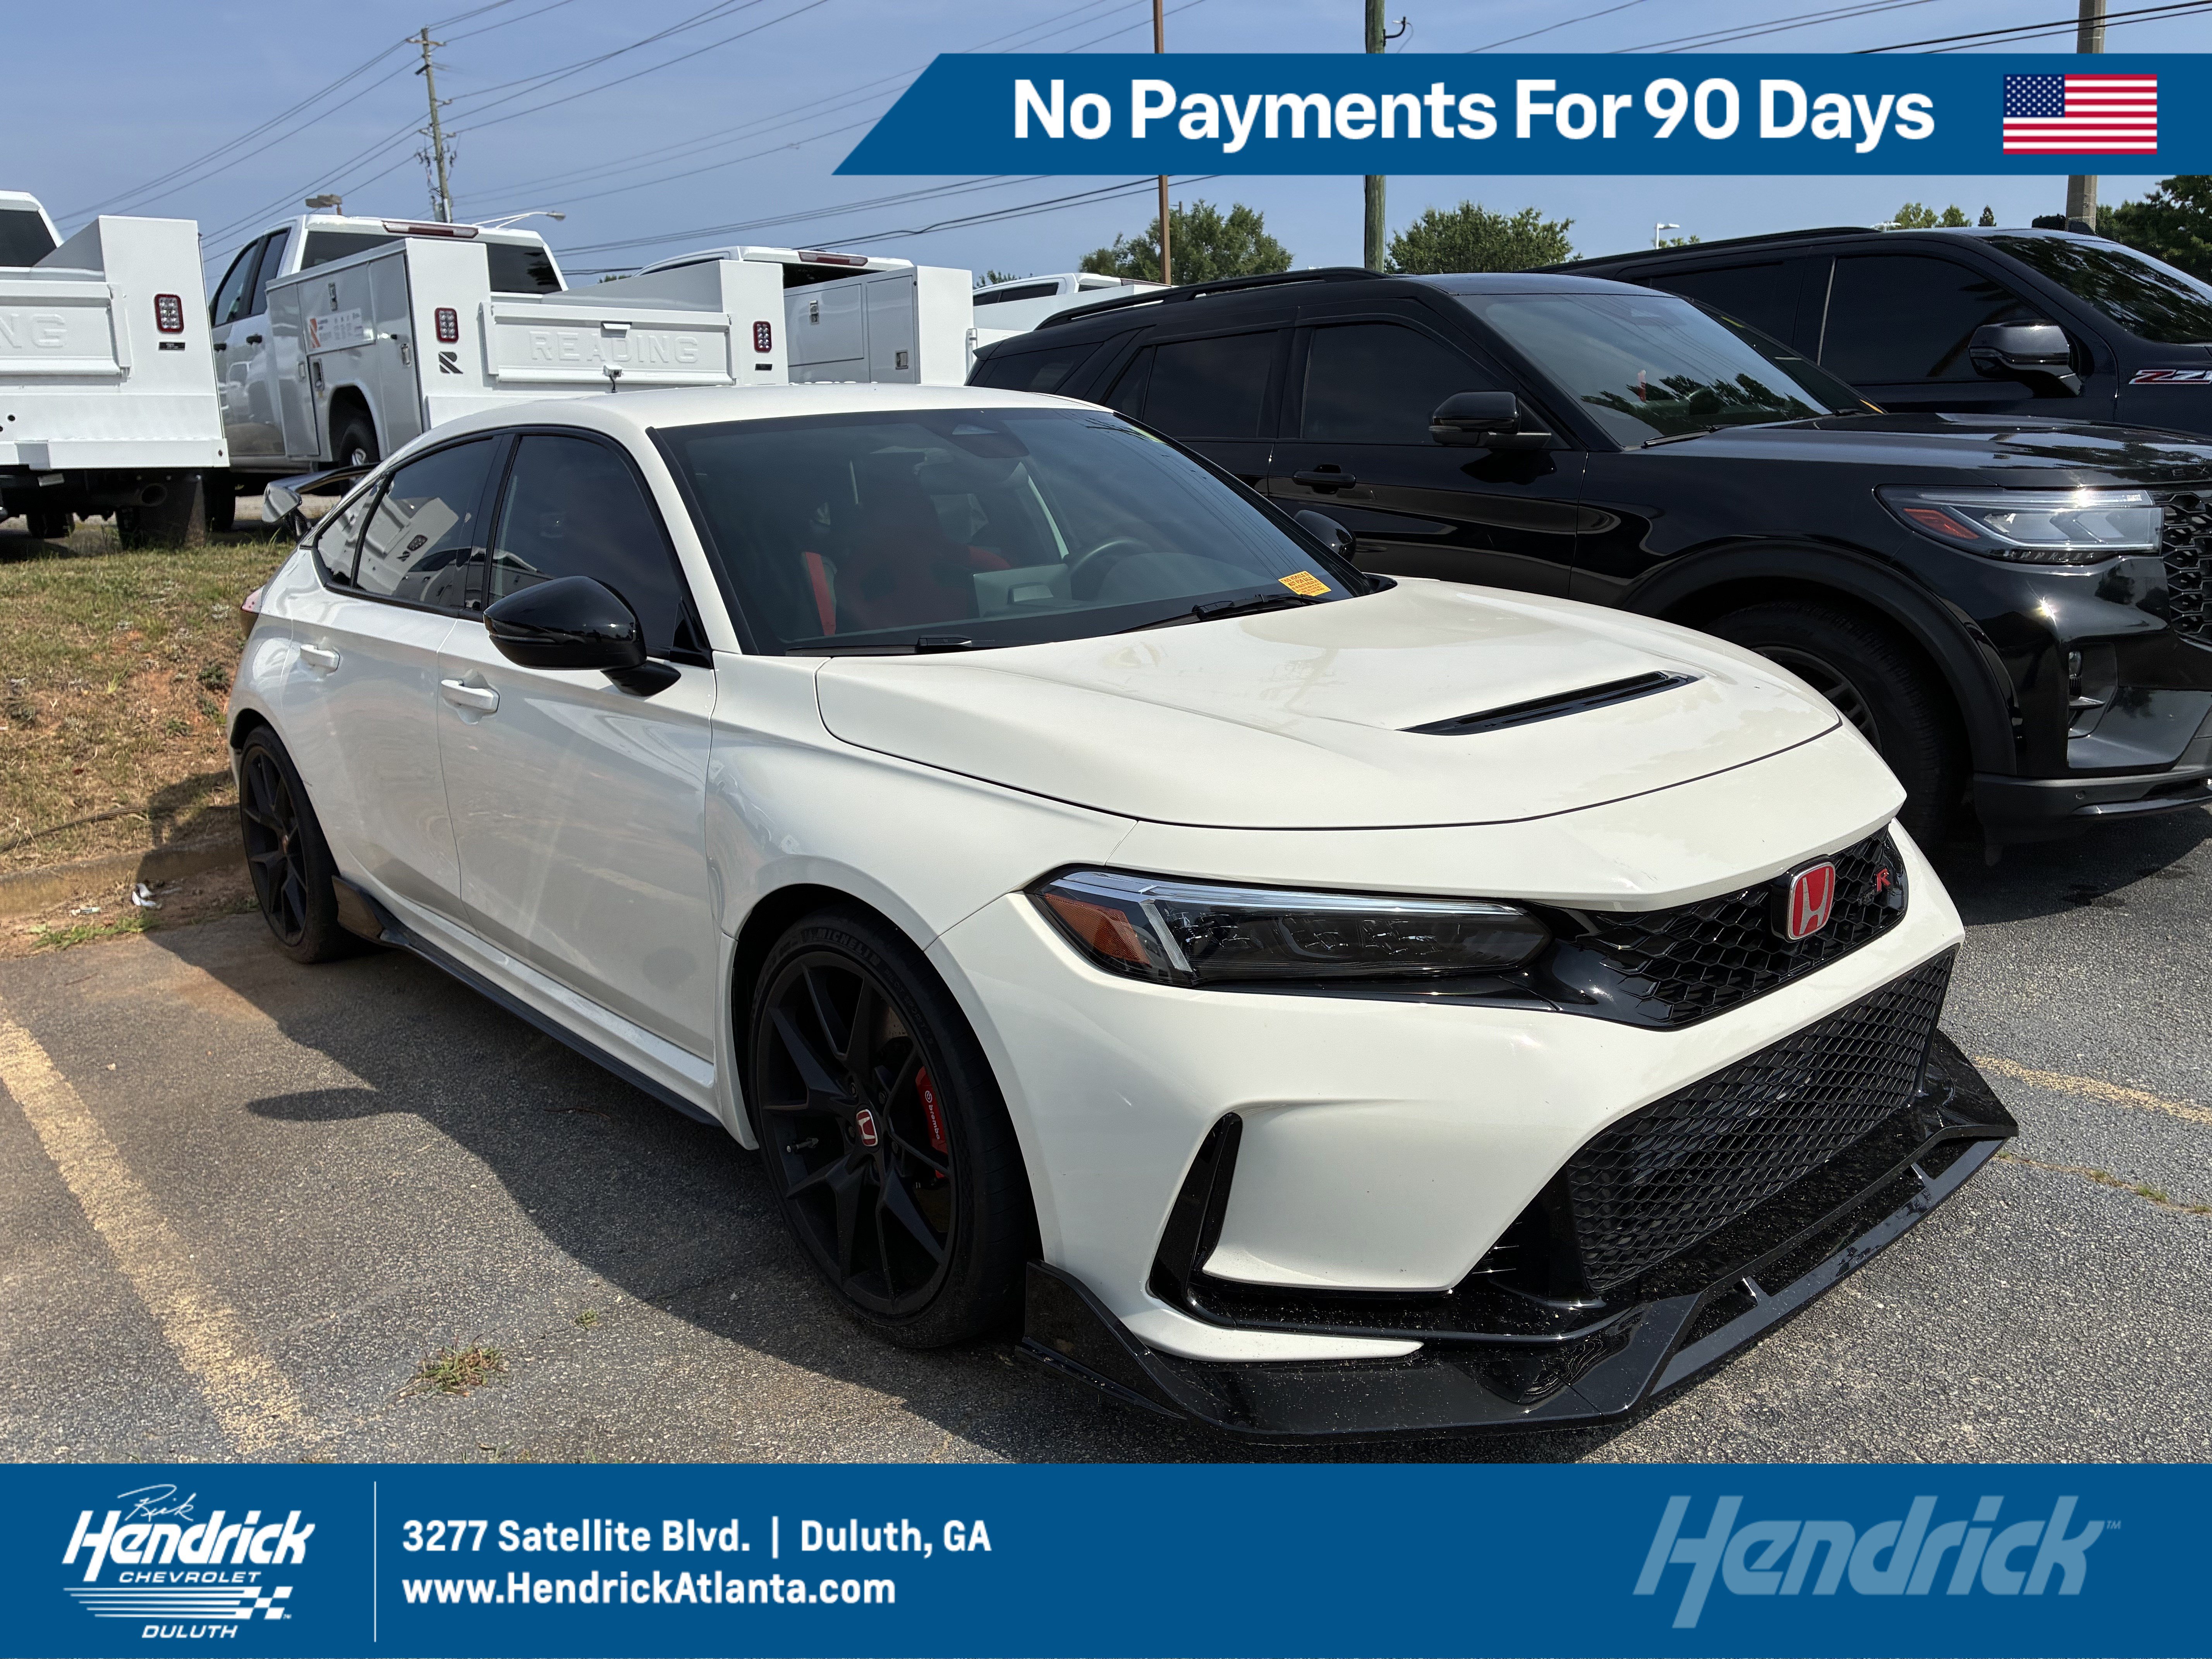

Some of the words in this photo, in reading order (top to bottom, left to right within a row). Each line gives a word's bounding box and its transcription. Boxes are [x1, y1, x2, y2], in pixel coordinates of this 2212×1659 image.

[529, 331, 699, 363] READING
[816, 928, 882, 966] MICHELIN
[884, 968, 905, 993] PILOT
[929, 1104, 940, 1140] brembo
